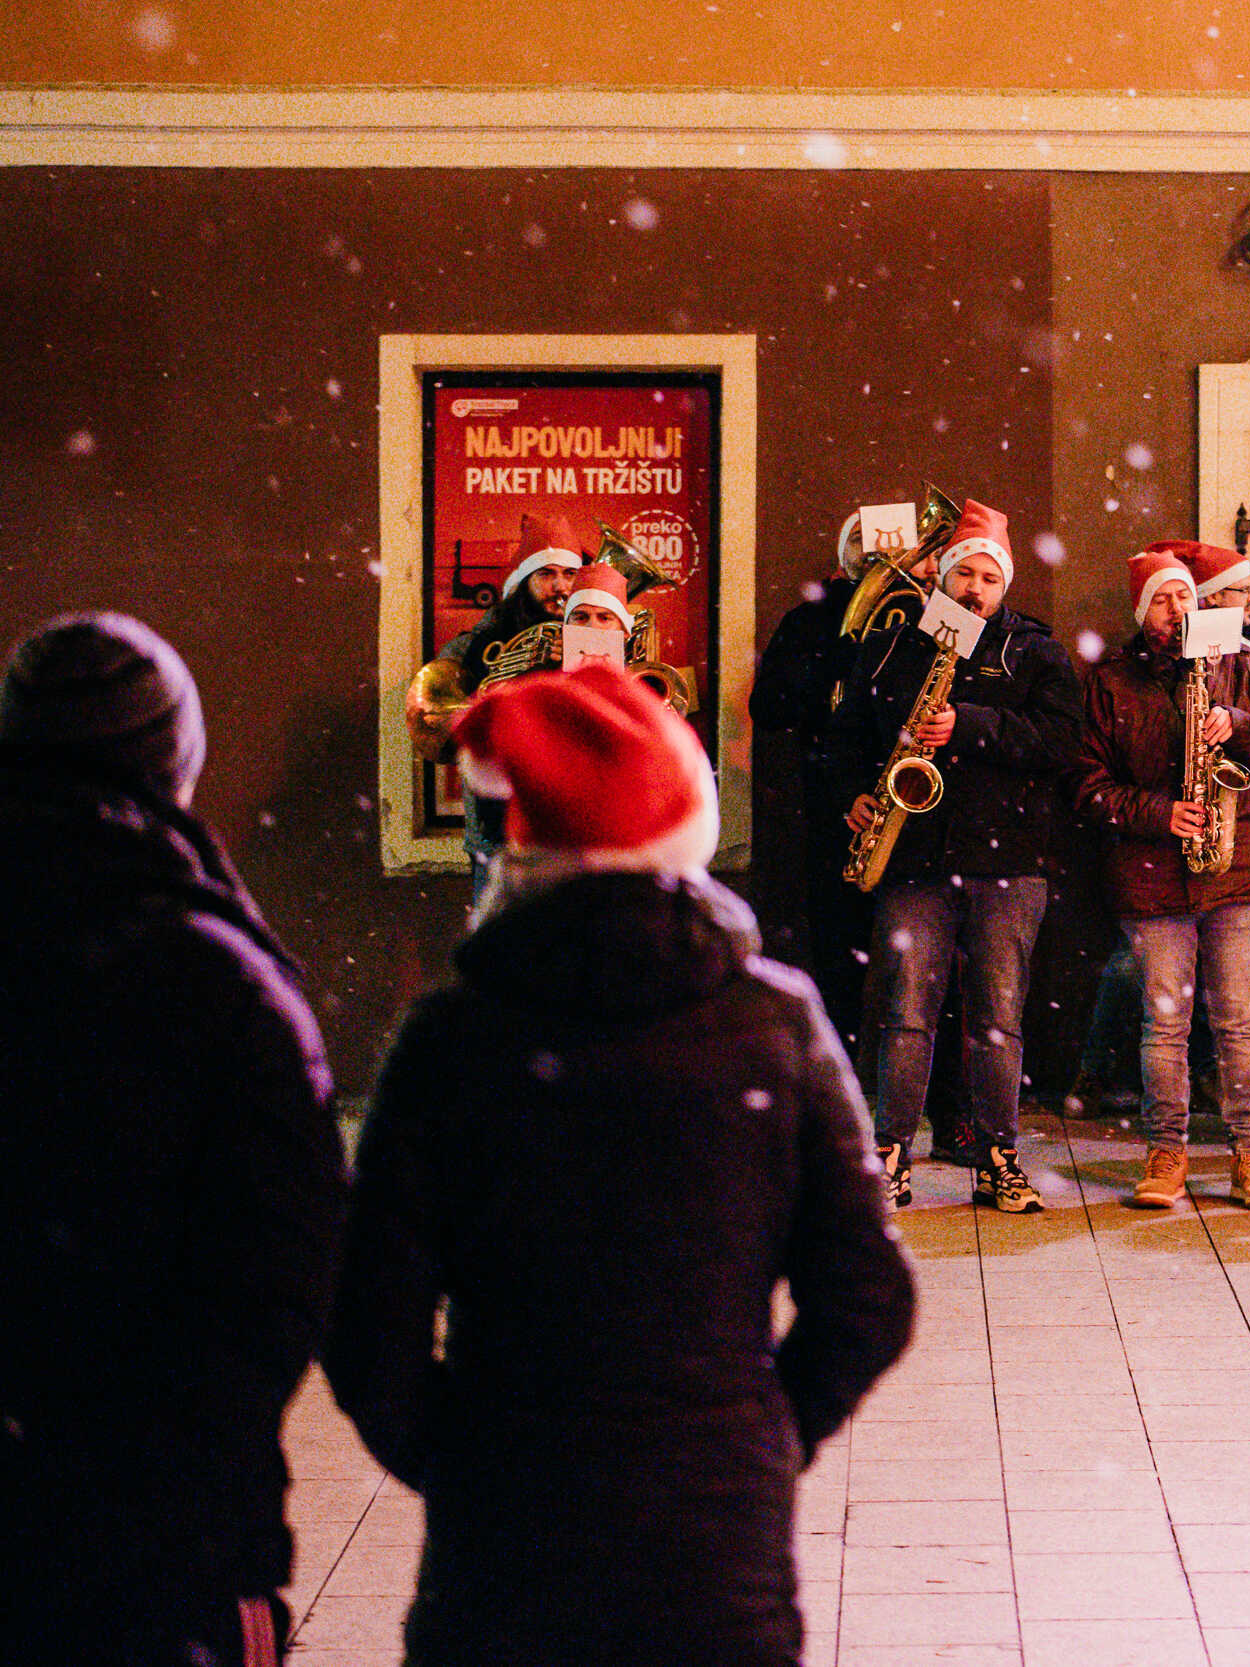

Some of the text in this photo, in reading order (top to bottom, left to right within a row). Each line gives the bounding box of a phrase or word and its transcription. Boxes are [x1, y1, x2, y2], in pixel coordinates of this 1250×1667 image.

[465, 426, 682, 458] NAJPOVOLJNIJI
[465, 460, 682, 494] PAKET NA TRŽIŠTU
[632, 519, 683, 536] preko
